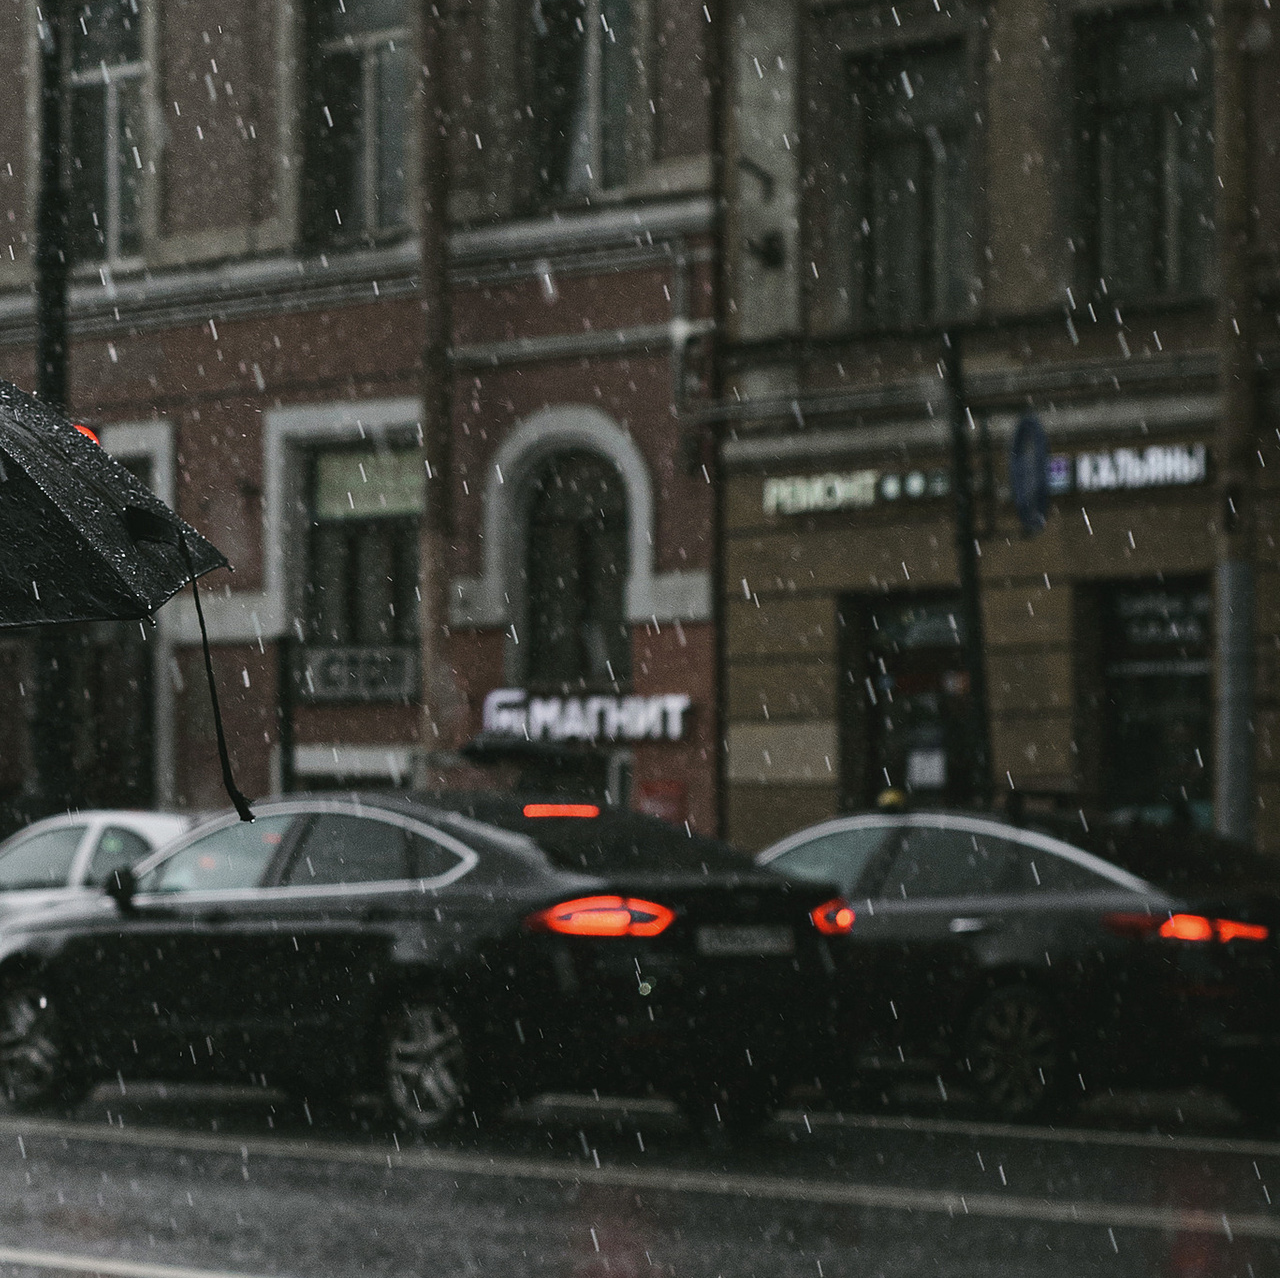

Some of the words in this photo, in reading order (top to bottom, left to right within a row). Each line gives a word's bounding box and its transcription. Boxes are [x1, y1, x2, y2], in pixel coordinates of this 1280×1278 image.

[1075, 442, 1207, 491] КАЛЬЯНЫ
[762, 468, 878, 515] РЕМОНТ
[527, 692, 691, 741] МАГНИТ
